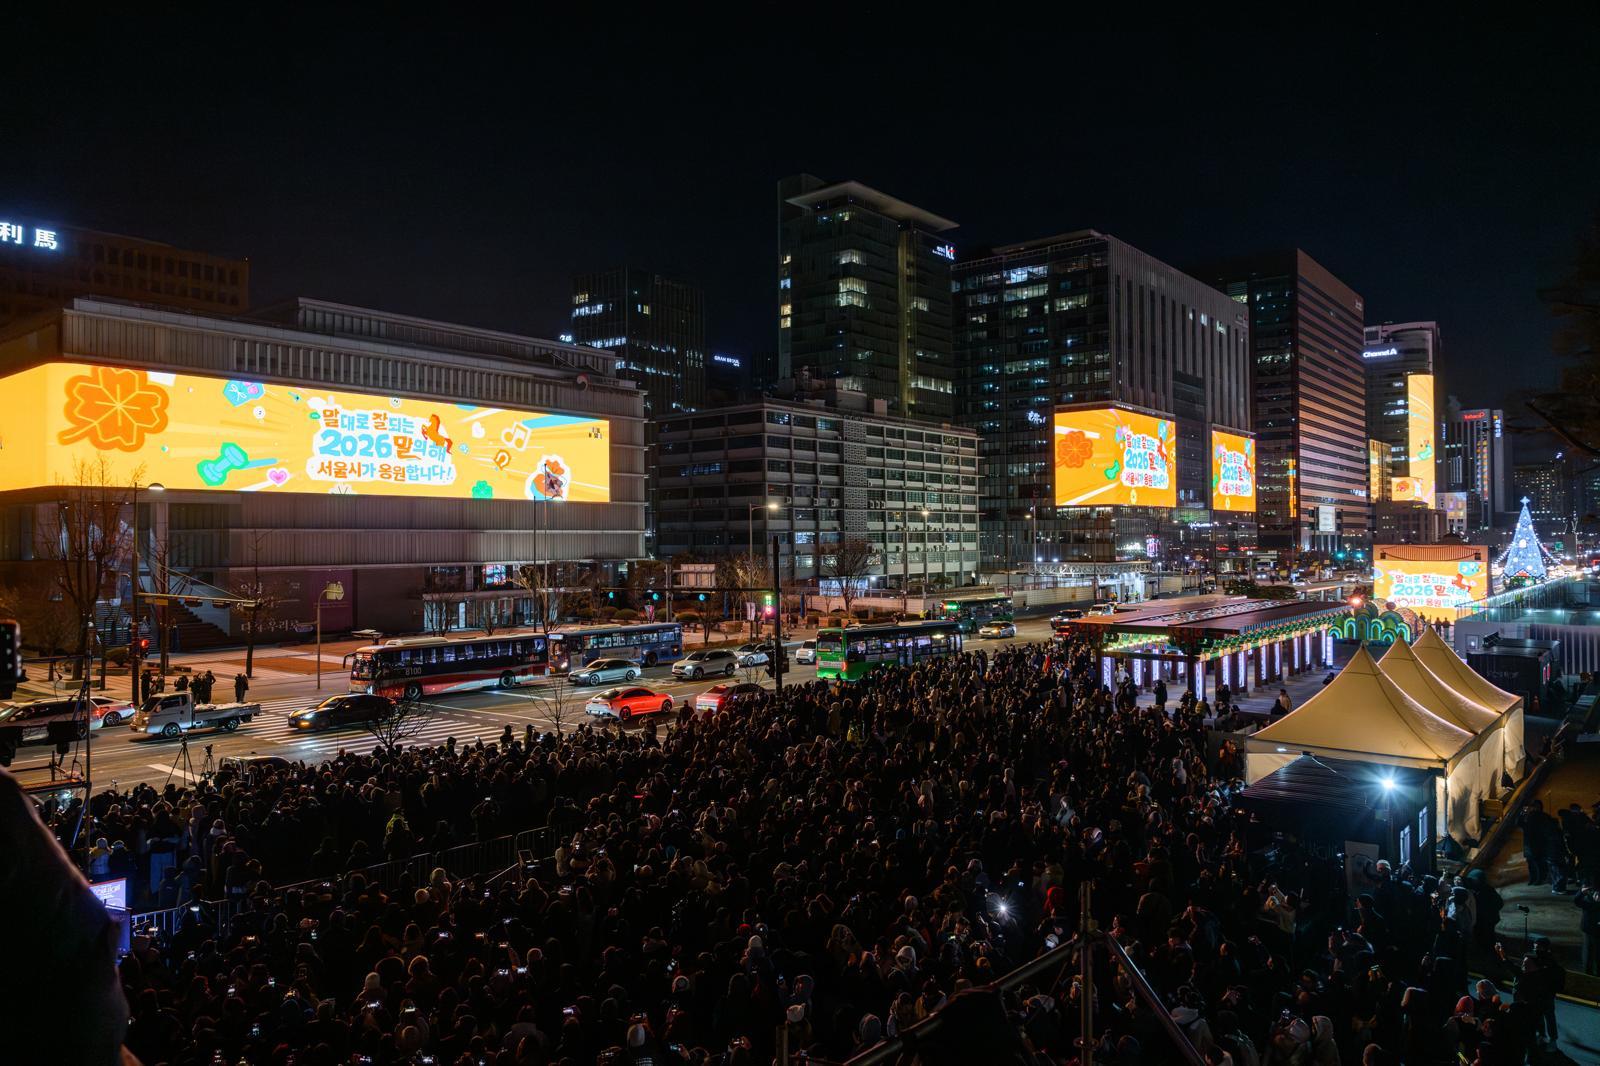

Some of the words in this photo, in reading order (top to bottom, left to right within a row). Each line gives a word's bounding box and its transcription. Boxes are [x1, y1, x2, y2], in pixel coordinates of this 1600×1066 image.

[945, 245, 957, 260] kt
[322, 408, 370, 431] 말대로
[371, 411, 415, 434] 잘되는
[319, 429, 392, 458] 2026
[1125, 448, 1148, 470] 2026
[317, 461, 376, 479] 서울시가
[378, 463, 453, 482] 응원합니다!
[1394, 584, 1433, 596] 2026
